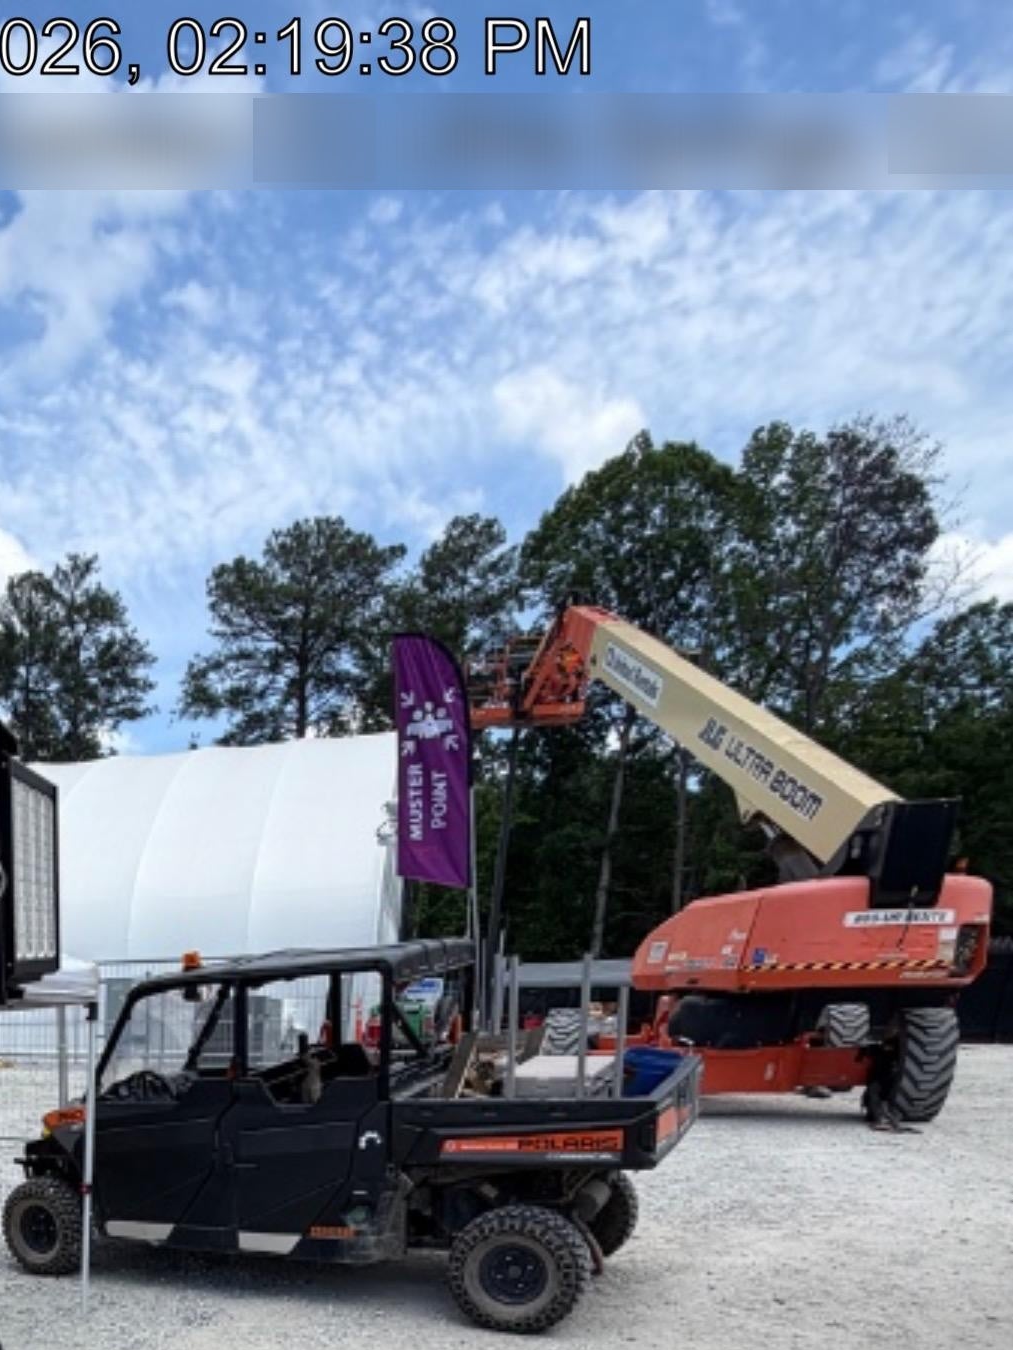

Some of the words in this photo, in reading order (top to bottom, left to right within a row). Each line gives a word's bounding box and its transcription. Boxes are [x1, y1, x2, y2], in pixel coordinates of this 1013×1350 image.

[407, 762, 423, 840] MUSTER
[430, 770, 447, 829] POINT
[725, 736, 774, 783] ULTRA
[769, 769, 823, 820] BOOM
[518, 1135, 619, 1152] POLARIS
